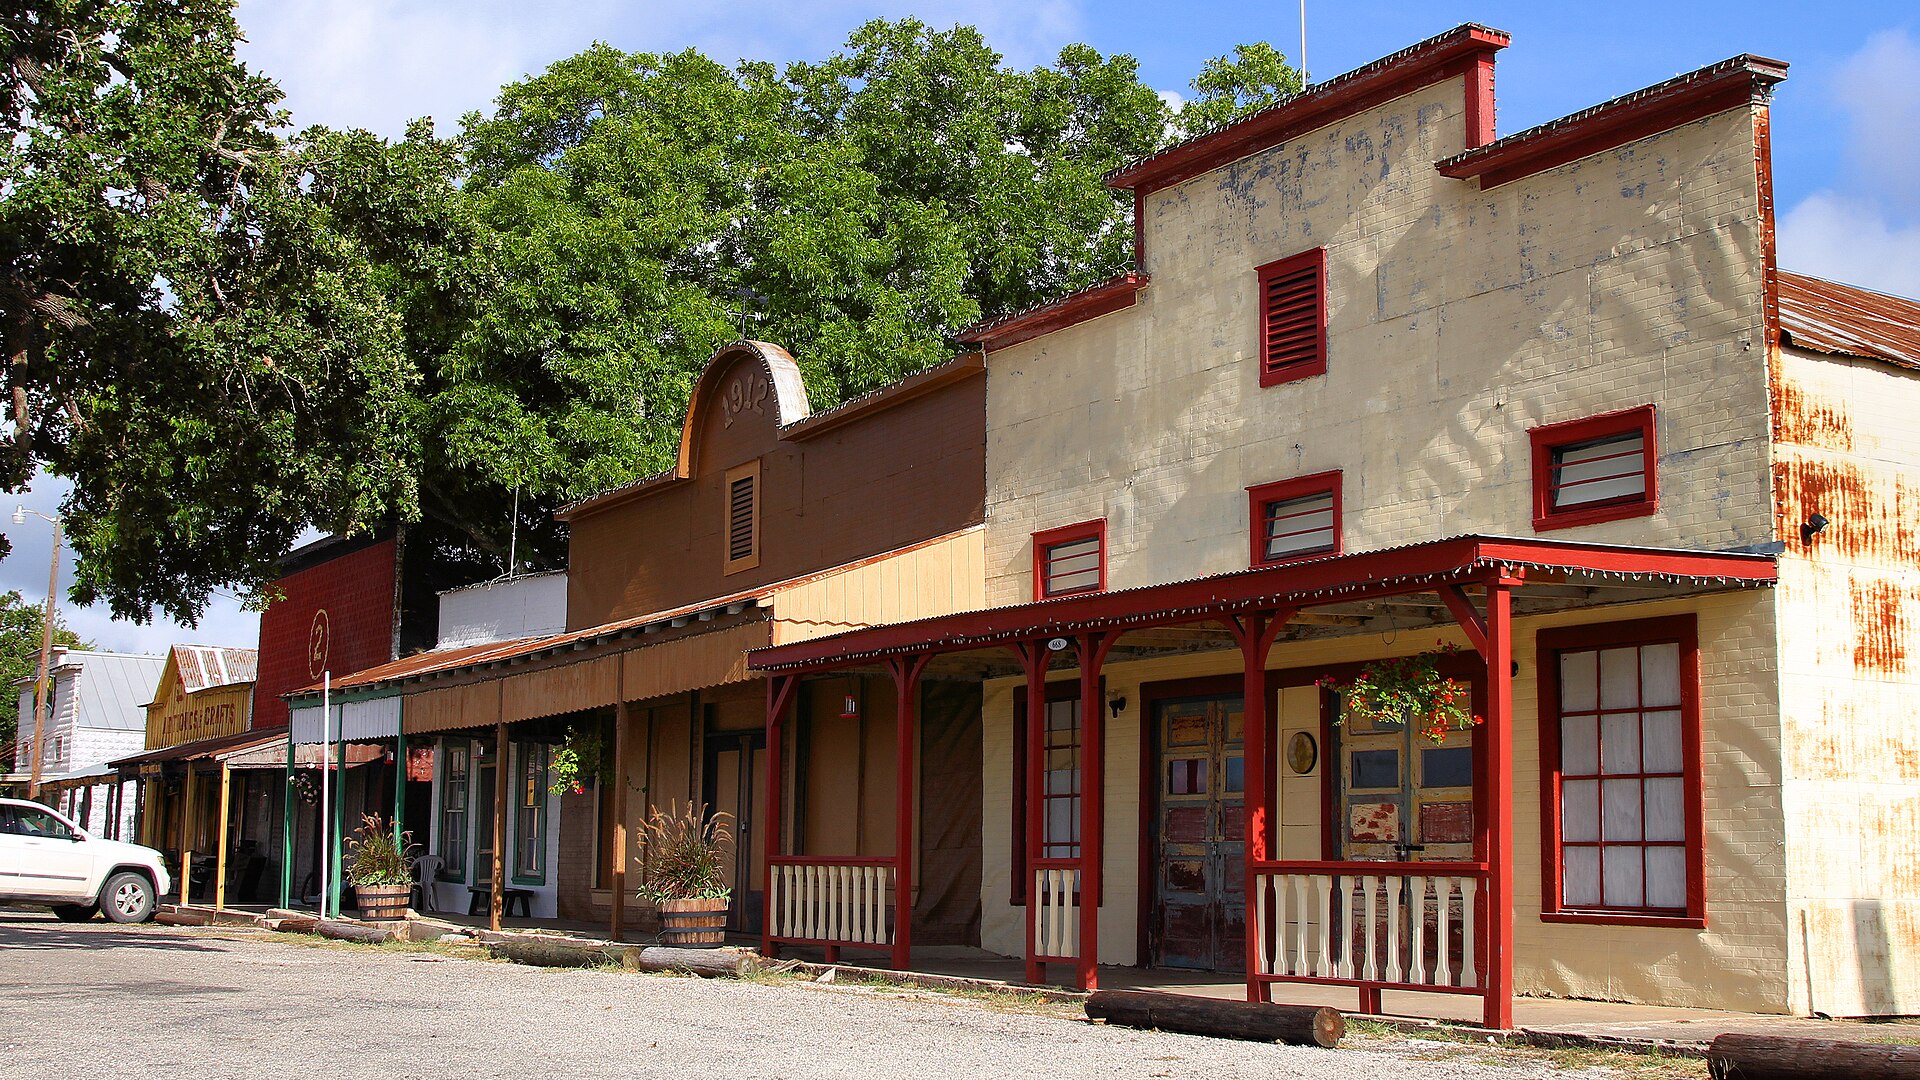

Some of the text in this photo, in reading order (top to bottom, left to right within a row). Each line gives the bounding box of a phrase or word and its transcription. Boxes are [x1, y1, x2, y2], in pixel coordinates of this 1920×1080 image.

[722, 372, 768, 430] 1912
[313, 624, 323, 661] 2
[205, 703, 236, 726] CRAFTS
